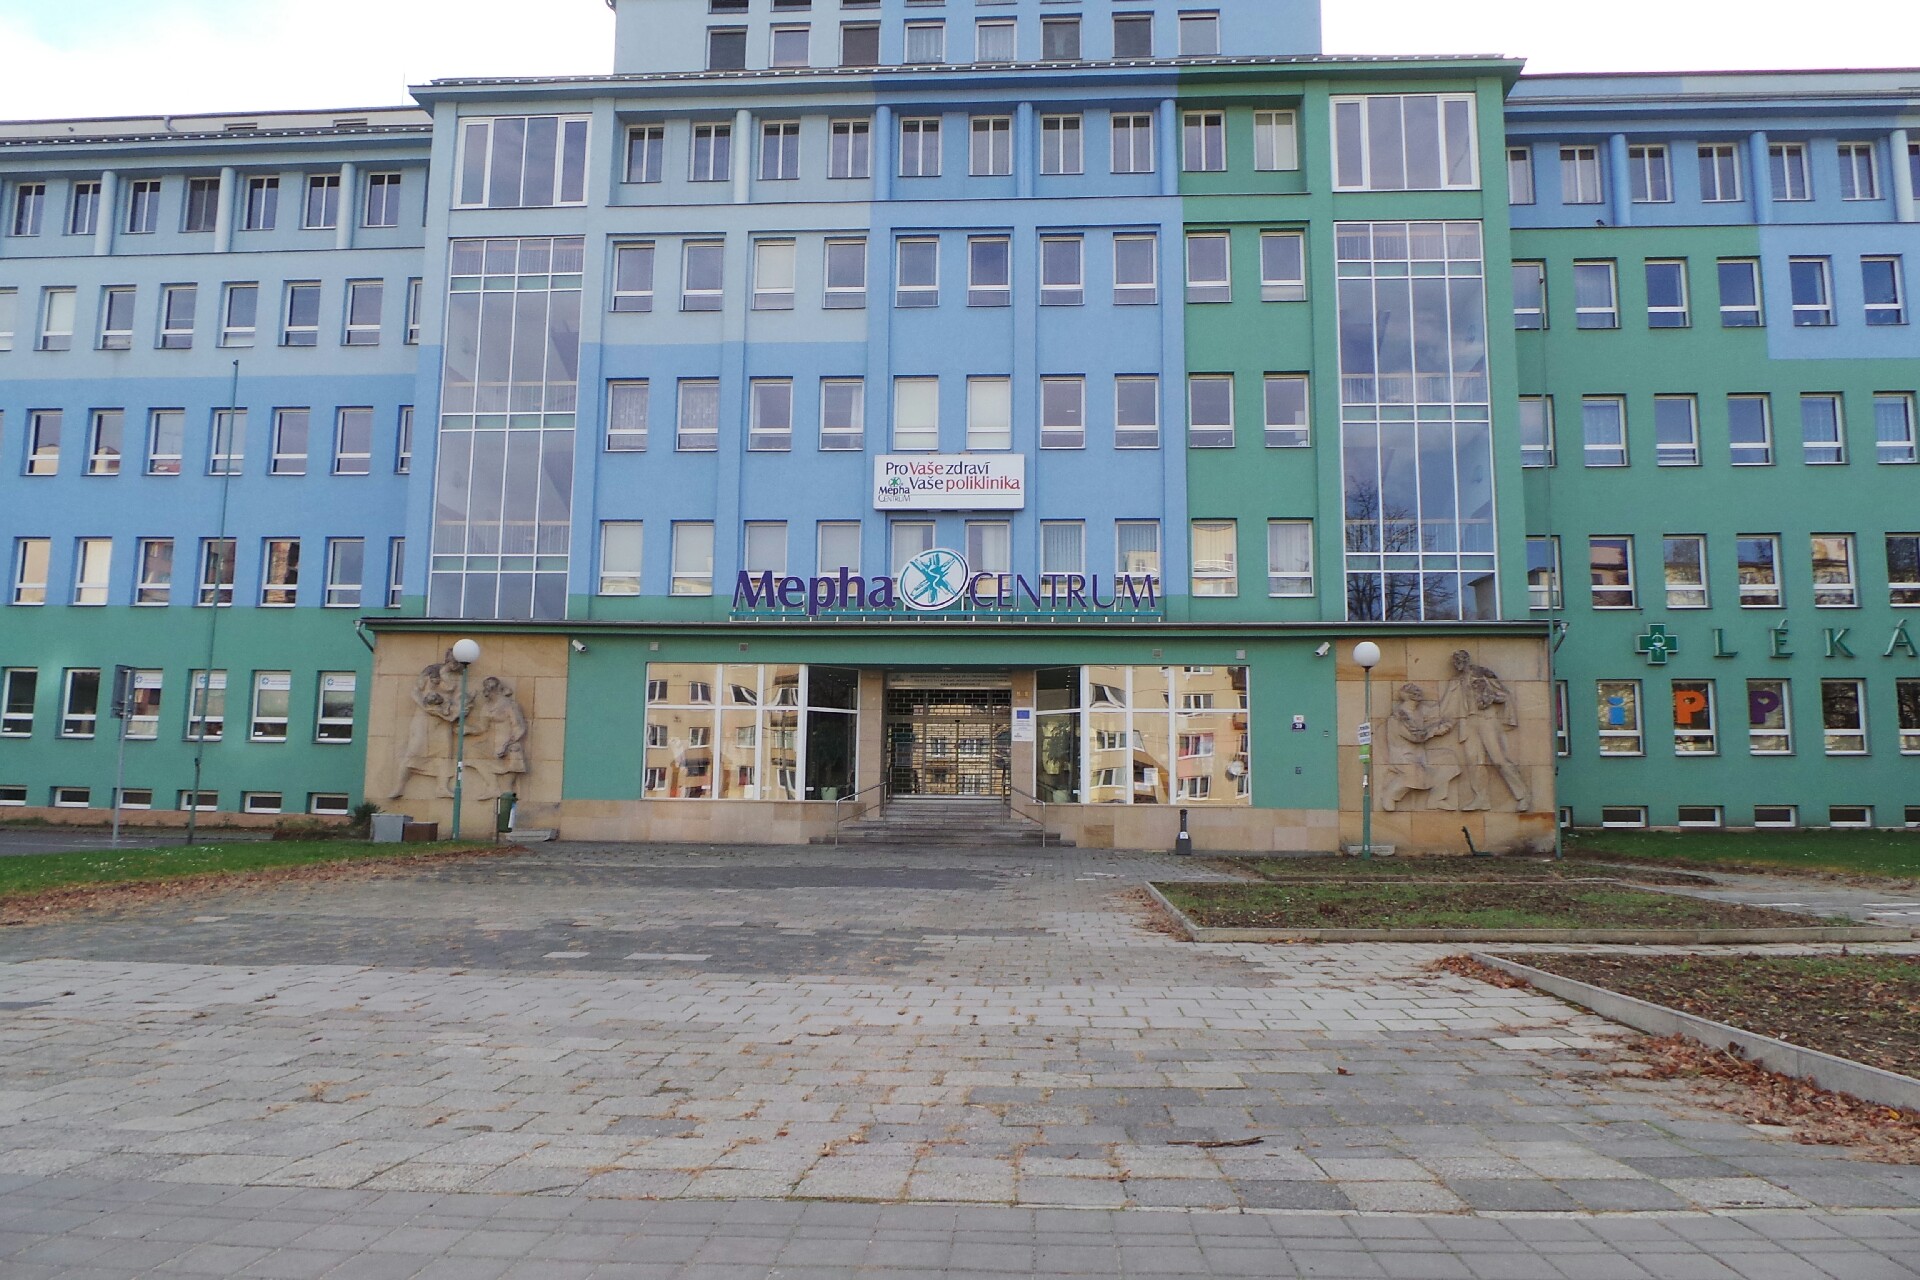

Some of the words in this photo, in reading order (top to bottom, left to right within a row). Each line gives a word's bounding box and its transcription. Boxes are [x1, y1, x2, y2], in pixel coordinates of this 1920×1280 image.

[885, 461, 908, 475] Pro
[909, 461, 944, 475] Vaše
[945, 460, 991, 475] zdraví
[878, 485, 911, 496] Mepha
[909, 476, 944, 490] Vaše
[945, 475, 1021, 492] poliklinika
[877, 494, 911, 503] CENTRUM
[732, 566, 896, 616] Mepha
[968, 571, 1158, 610] CENTRUM
[1712, 618, 1919, 659] LÉKÁ
